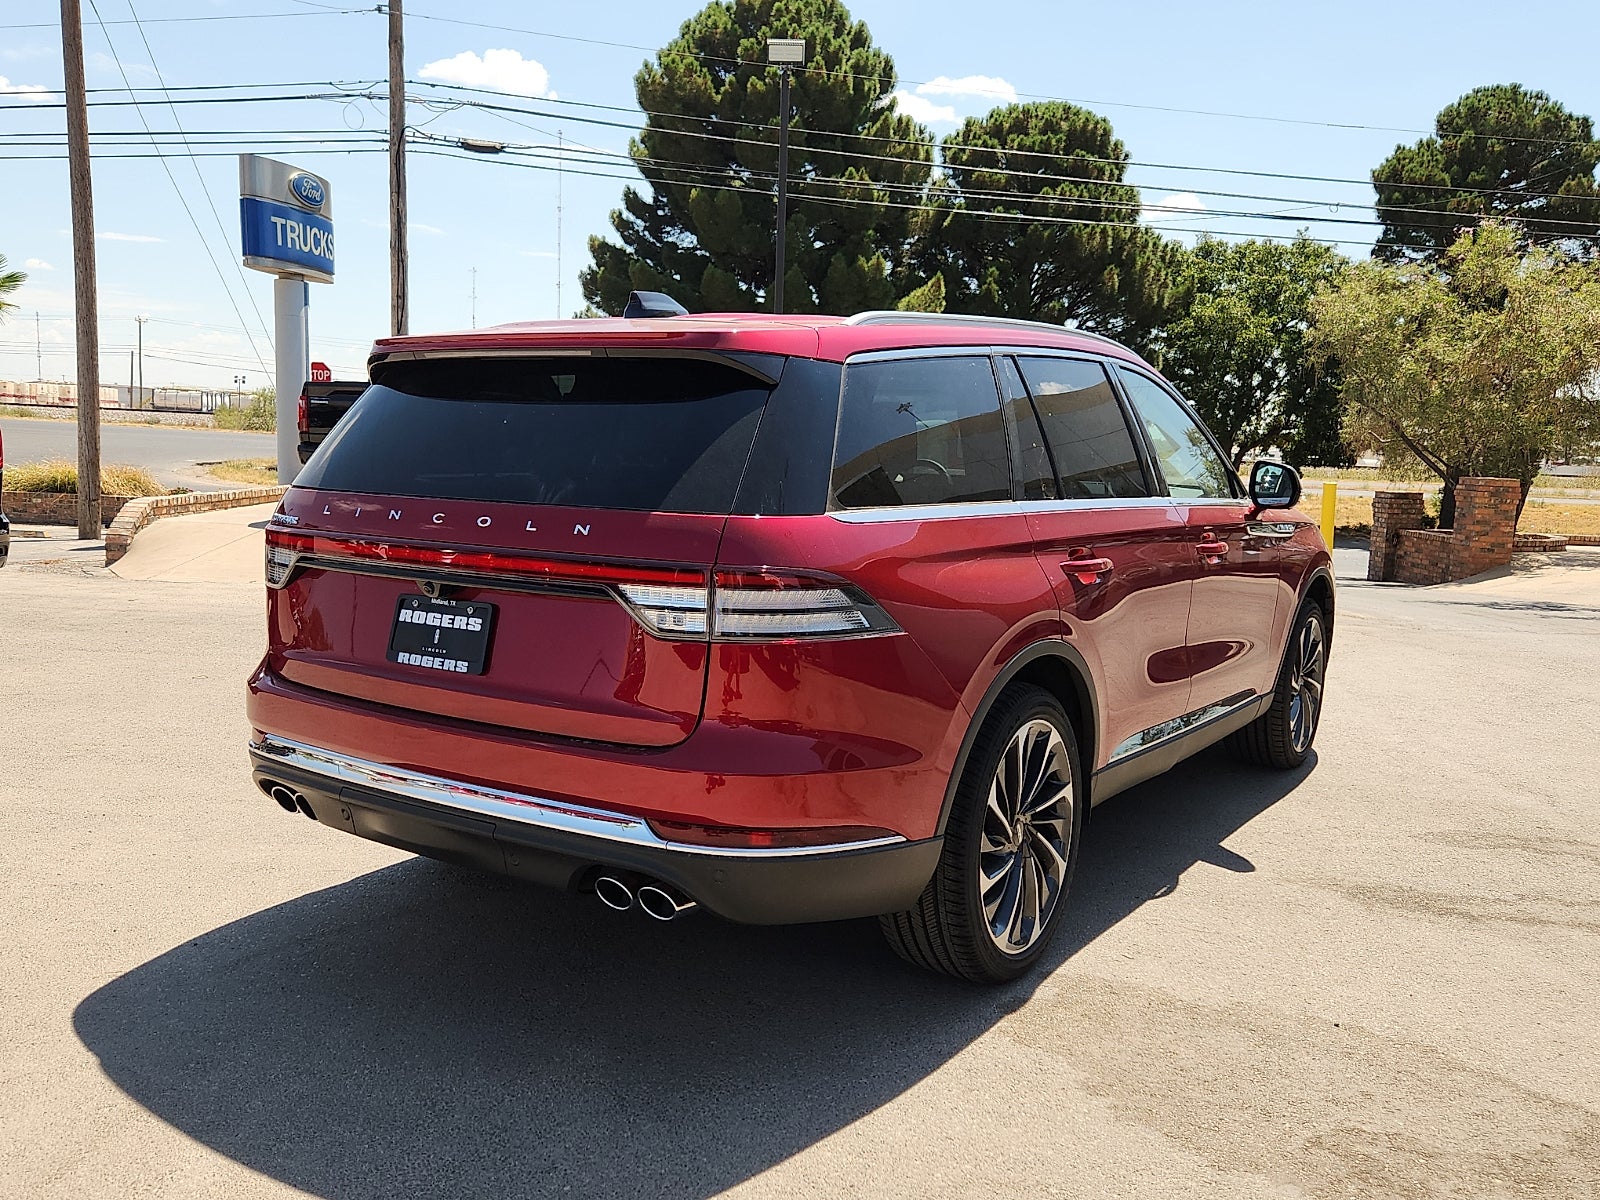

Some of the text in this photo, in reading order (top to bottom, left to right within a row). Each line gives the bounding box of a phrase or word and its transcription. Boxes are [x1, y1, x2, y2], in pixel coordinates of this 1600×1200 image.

[301, 178, 321, 201] Ford
[270, 215, 334, 261] TRUCKS
[312, 369, 330, 380] TOP
[323, 505, 591, 536] LINCOLN
[399, 609, 482, 632] ROGERS
[397, 652, 468, 673] ROGERS
